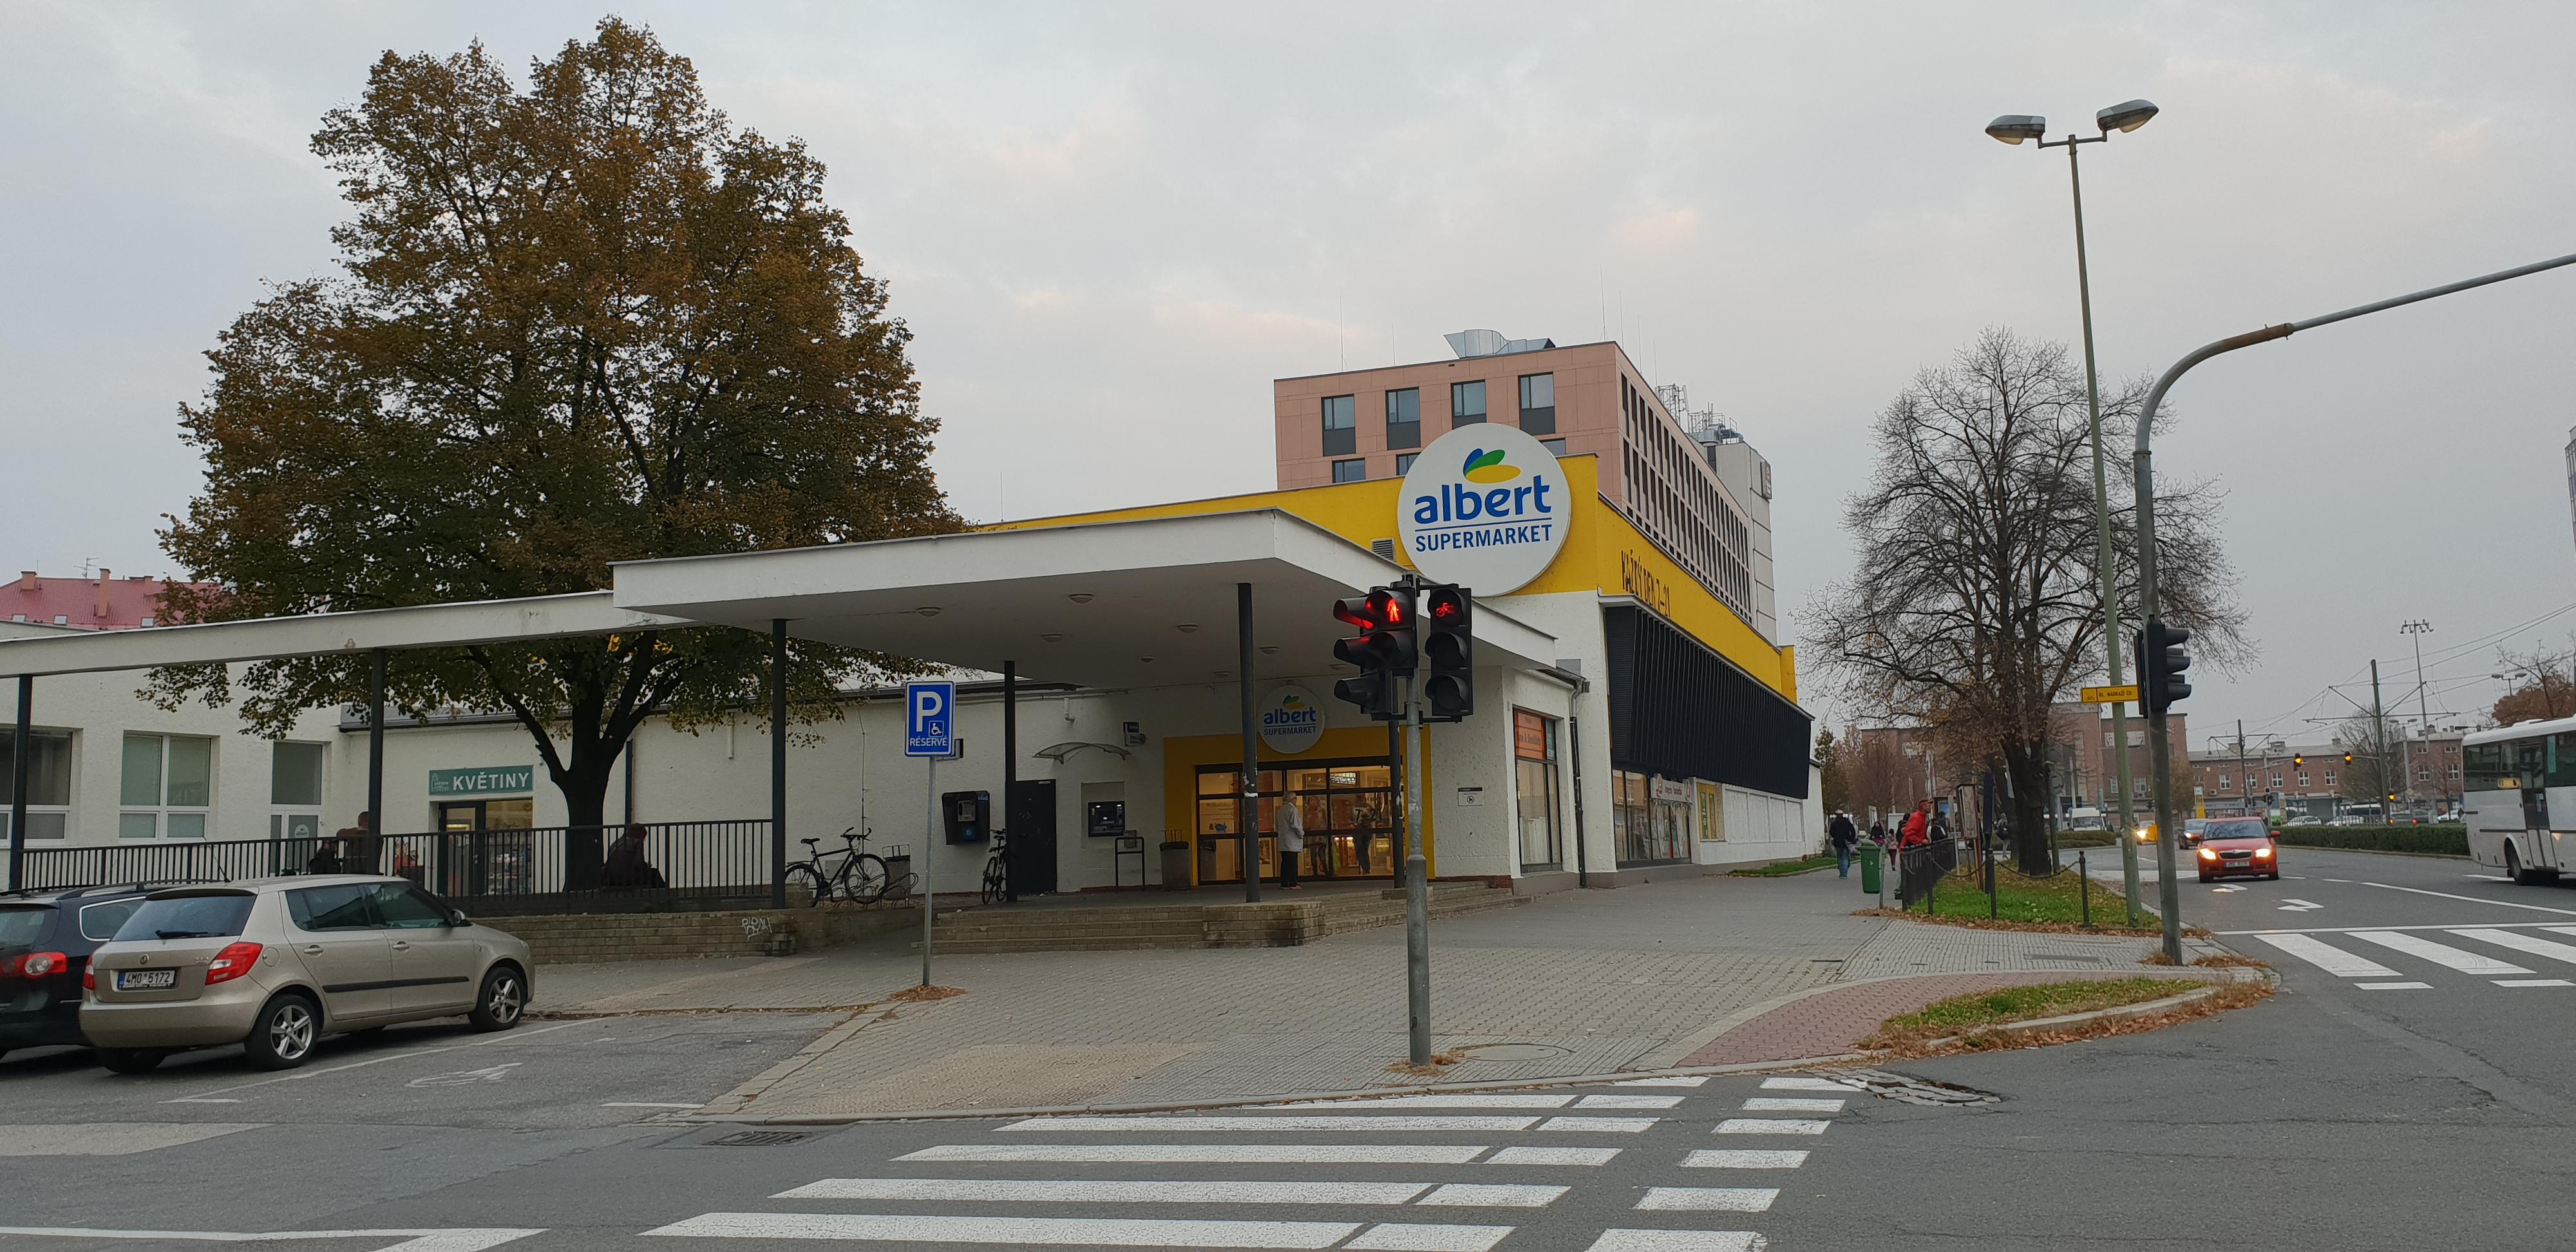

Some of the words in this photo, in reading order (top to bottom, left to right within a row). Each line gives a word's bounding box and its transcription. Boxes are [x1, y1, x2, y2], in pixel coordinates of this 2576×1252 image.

[1414, 475, 1552, 524] albert
[1416, 524, 1553, 553] SUPERMARKET
[1643, 567, 1656, 608] DEN
[1656, 578, 1671, 618] 7-21
[916, 691, 943, 732] P
[1264, 707, 1316, 725] albert
[1264, 726, 1316, 735] SUPERMARKET
[909, 735, 948, 746] RÉSERVÉ
[453, 772, 529, 791] KVĚTINY
[148, 971, 170, 983] 5172
